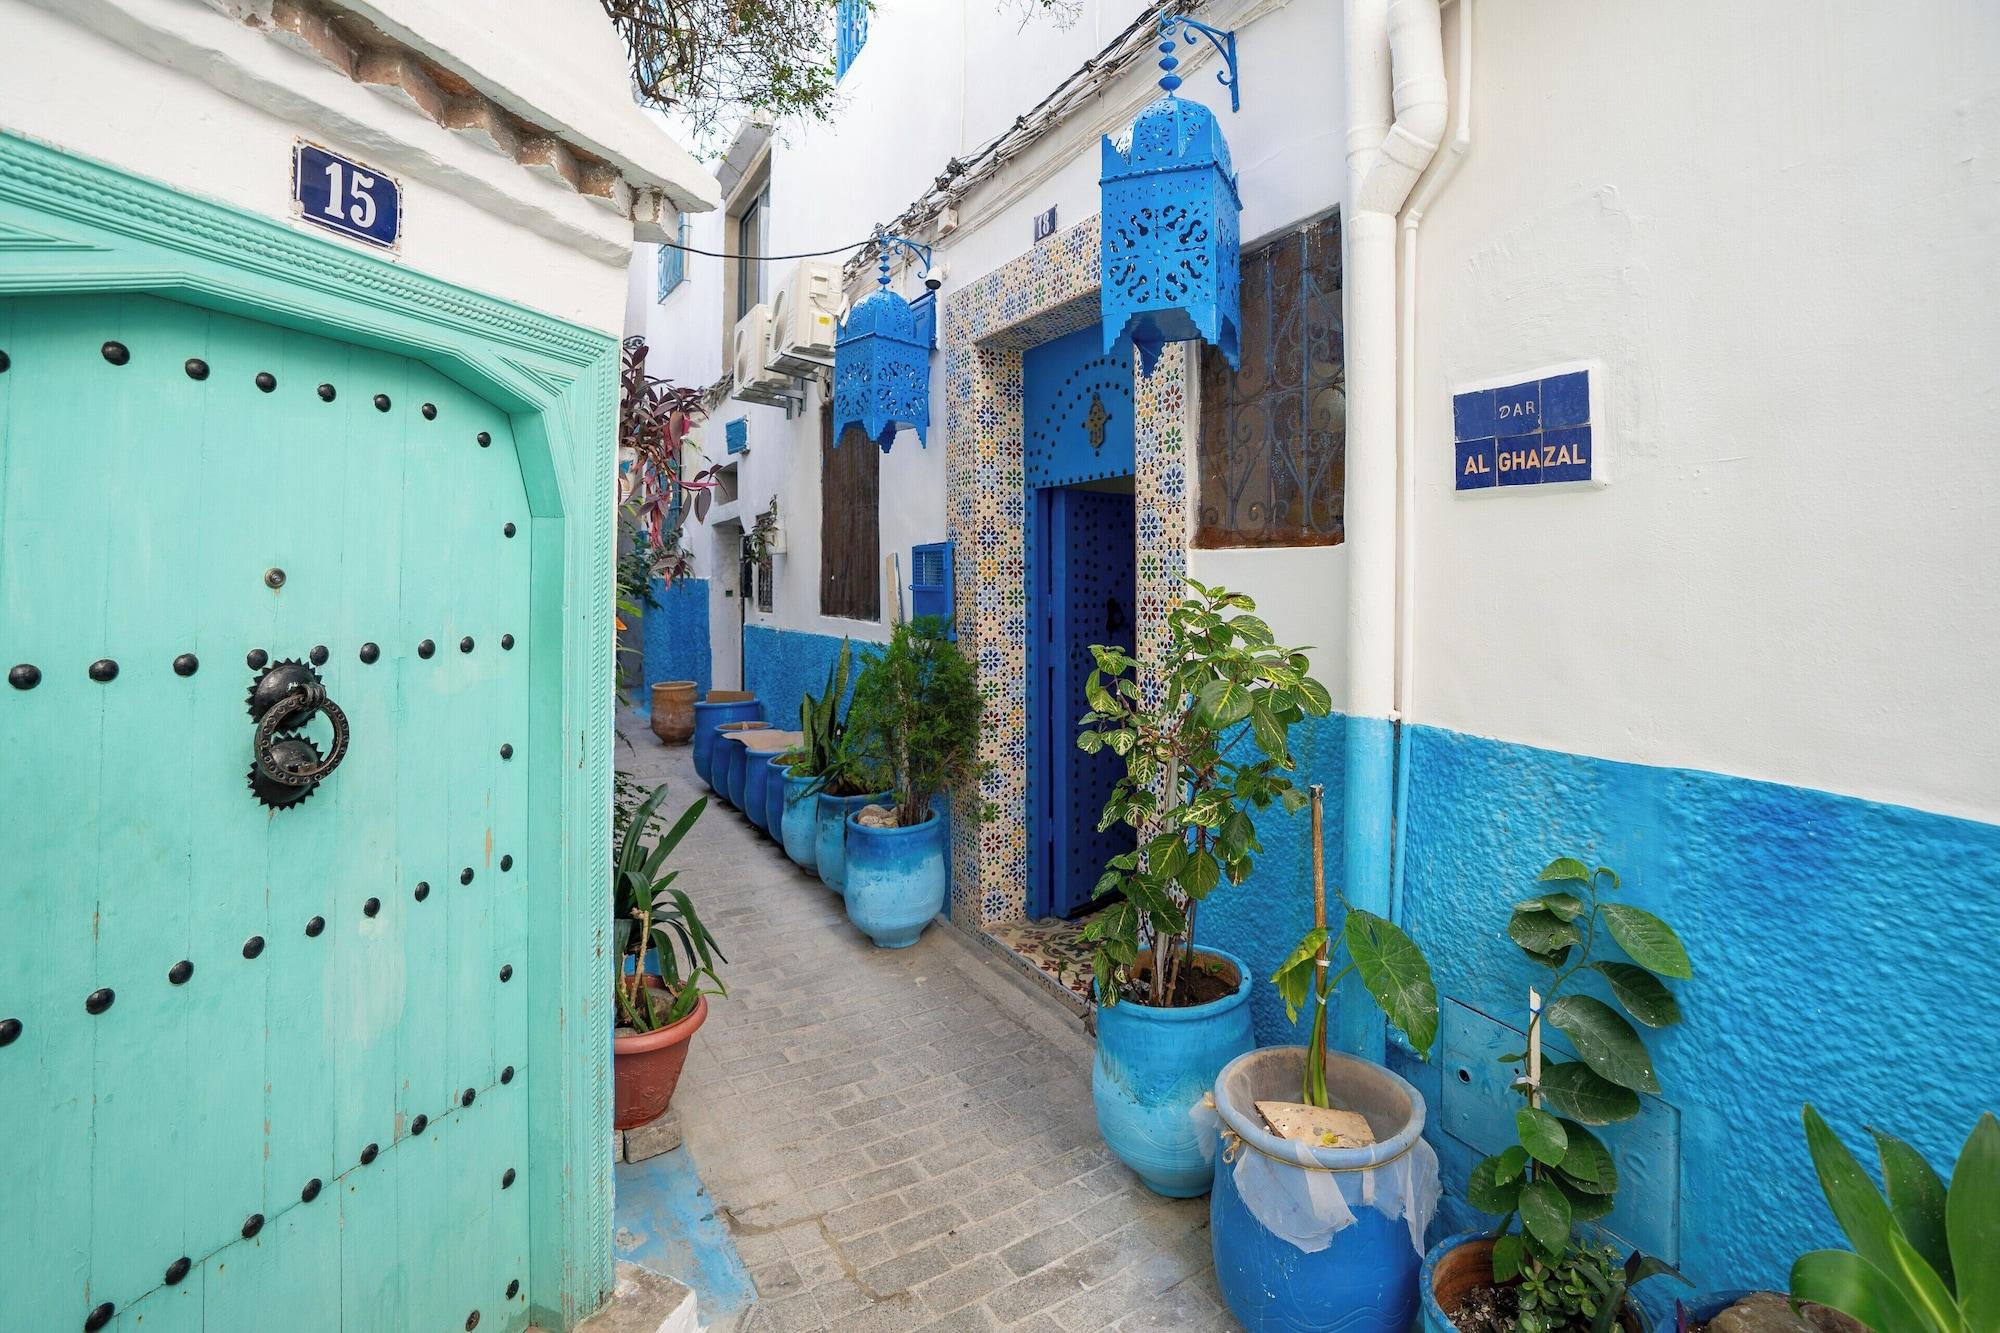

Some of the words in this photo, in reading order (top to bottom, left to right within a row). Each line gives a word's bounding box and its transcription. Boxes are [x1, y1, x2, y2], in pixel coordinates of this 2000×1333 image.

[324, 161, 377, 228] 15
[1037, 211, 1050, 239] 18
[1498, 400, 1536, 419] DAR
[1464, 454, 1491, 475] AL
[1498, 443, 1586, 472] GHAZAL
